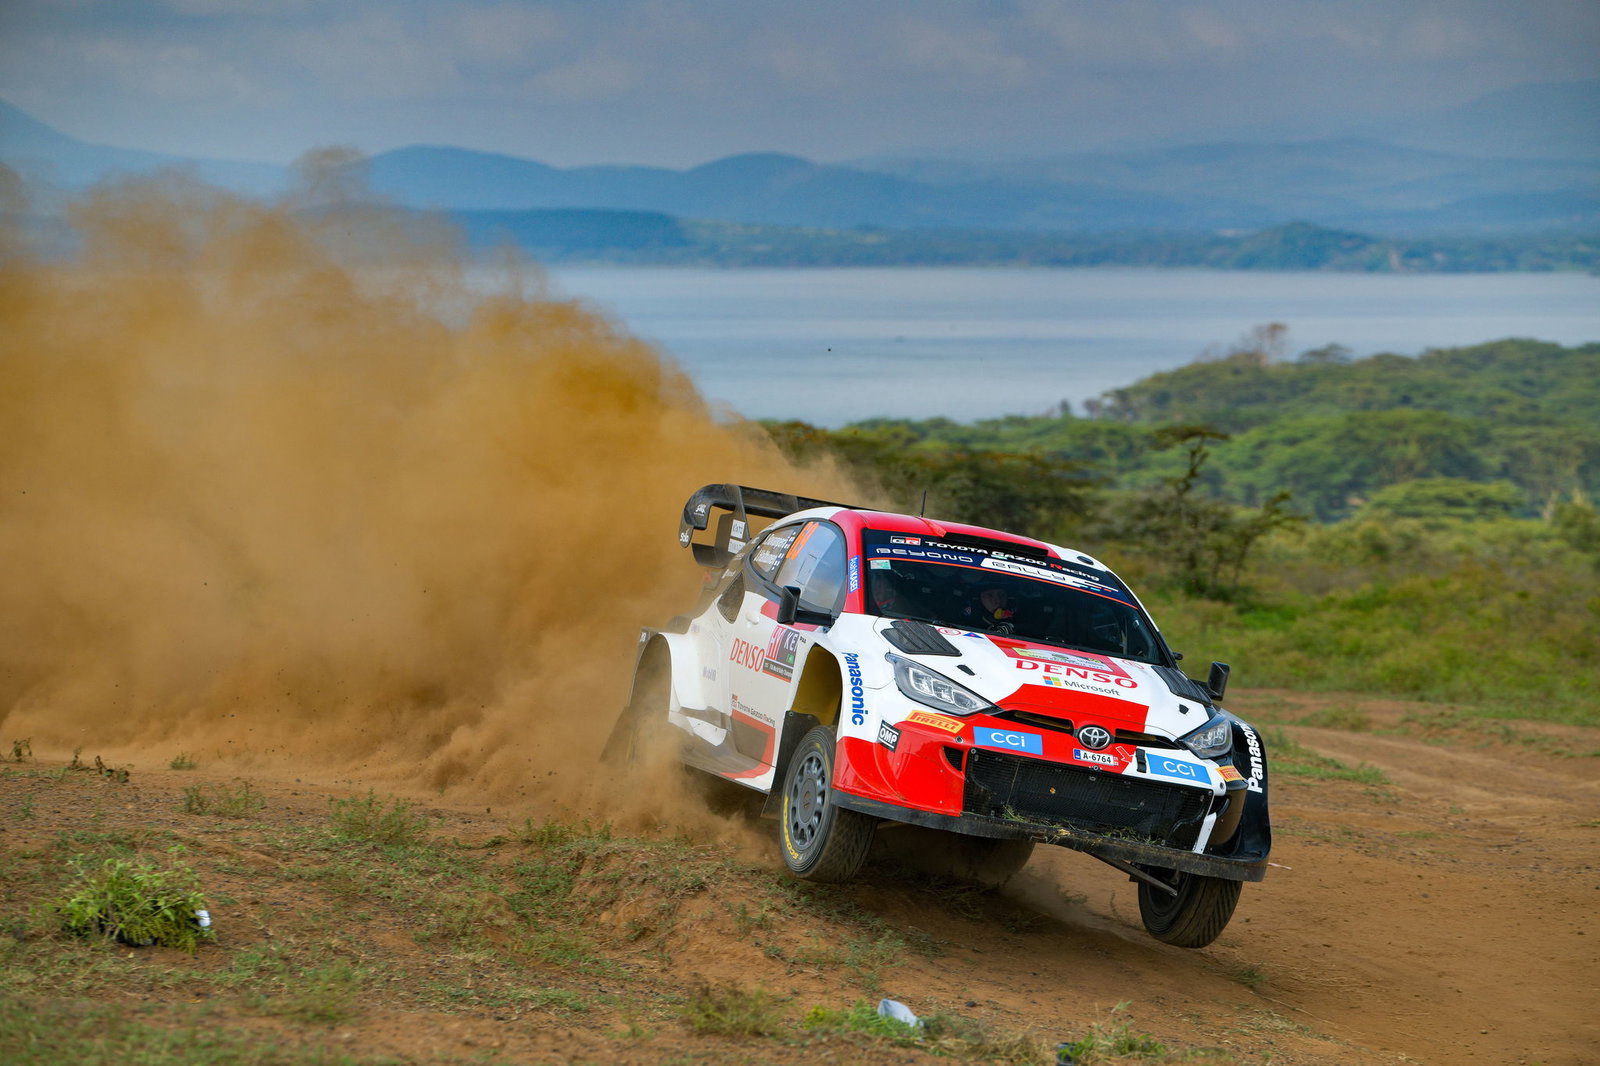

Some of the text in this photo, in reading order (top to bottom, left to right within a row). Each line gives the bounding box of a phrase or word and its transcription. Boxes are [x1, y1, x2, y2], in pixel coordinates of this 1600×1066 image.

[876, 548, 974, 563] BEYOND
[925, 541, 988, 555] TOYOTA
[990, 551, 1047, 567] GAZOO
[1049, 563, 1100, 581] Racing
[991, 561, 1066, 581] RALLY
[729, 638, 766, 672] DENSO
[1016, 660, 1138, 688] DENSO
[841, 652, 869, 726] Panasonic
[1064, 680, 1120, 696] Microsoft
[910, 711, 959, 730] PIRELLI
[880, 727, 898, 744] OMP
[1082, 752, 1111, 764] A-6764
